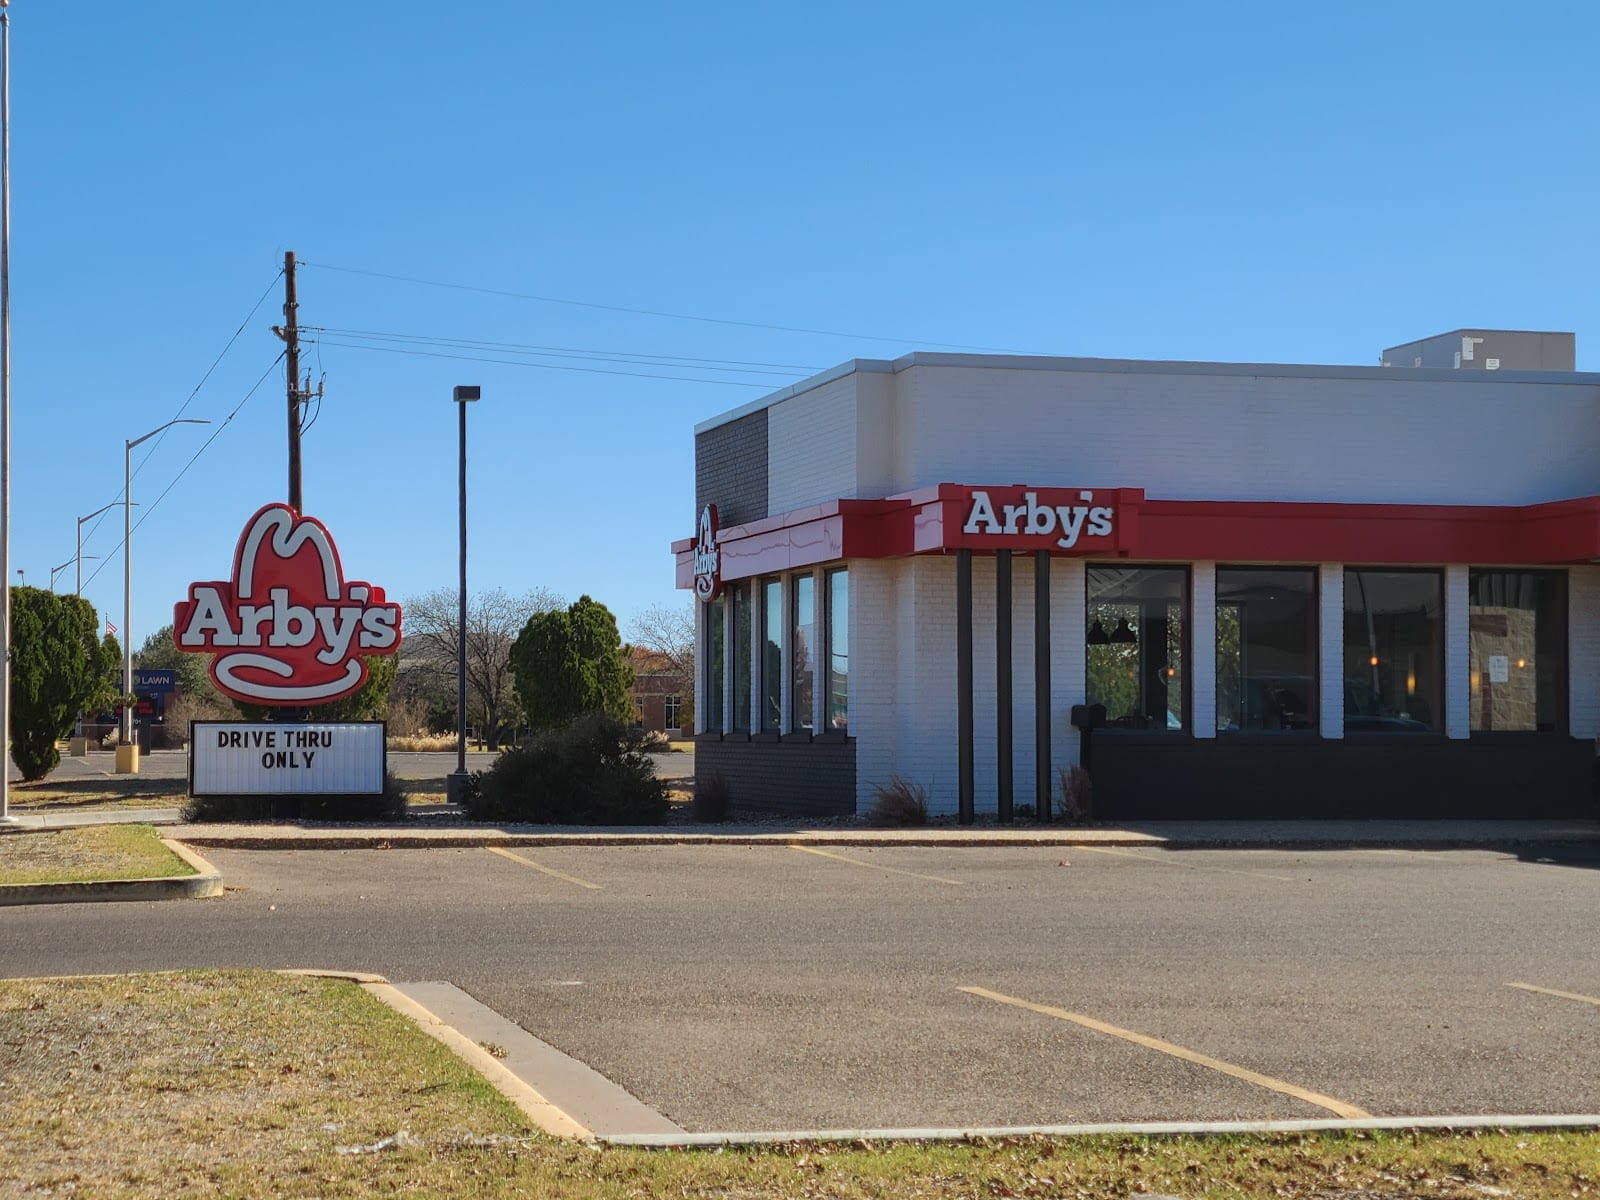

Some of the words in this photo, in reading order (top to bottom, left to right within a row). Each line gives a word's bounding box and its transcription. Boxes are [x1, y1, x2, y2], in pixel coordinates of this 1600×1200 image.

[963, 491, 1113, 548] Arby's
[181, 586, 396, 665] Arby's
[141, 676, 170, 685] LAWN
[217, 731, 276, 748] DRIVE
[284, 731, 332, 748] THRU
[261, 751, 315, 769] ONLY
